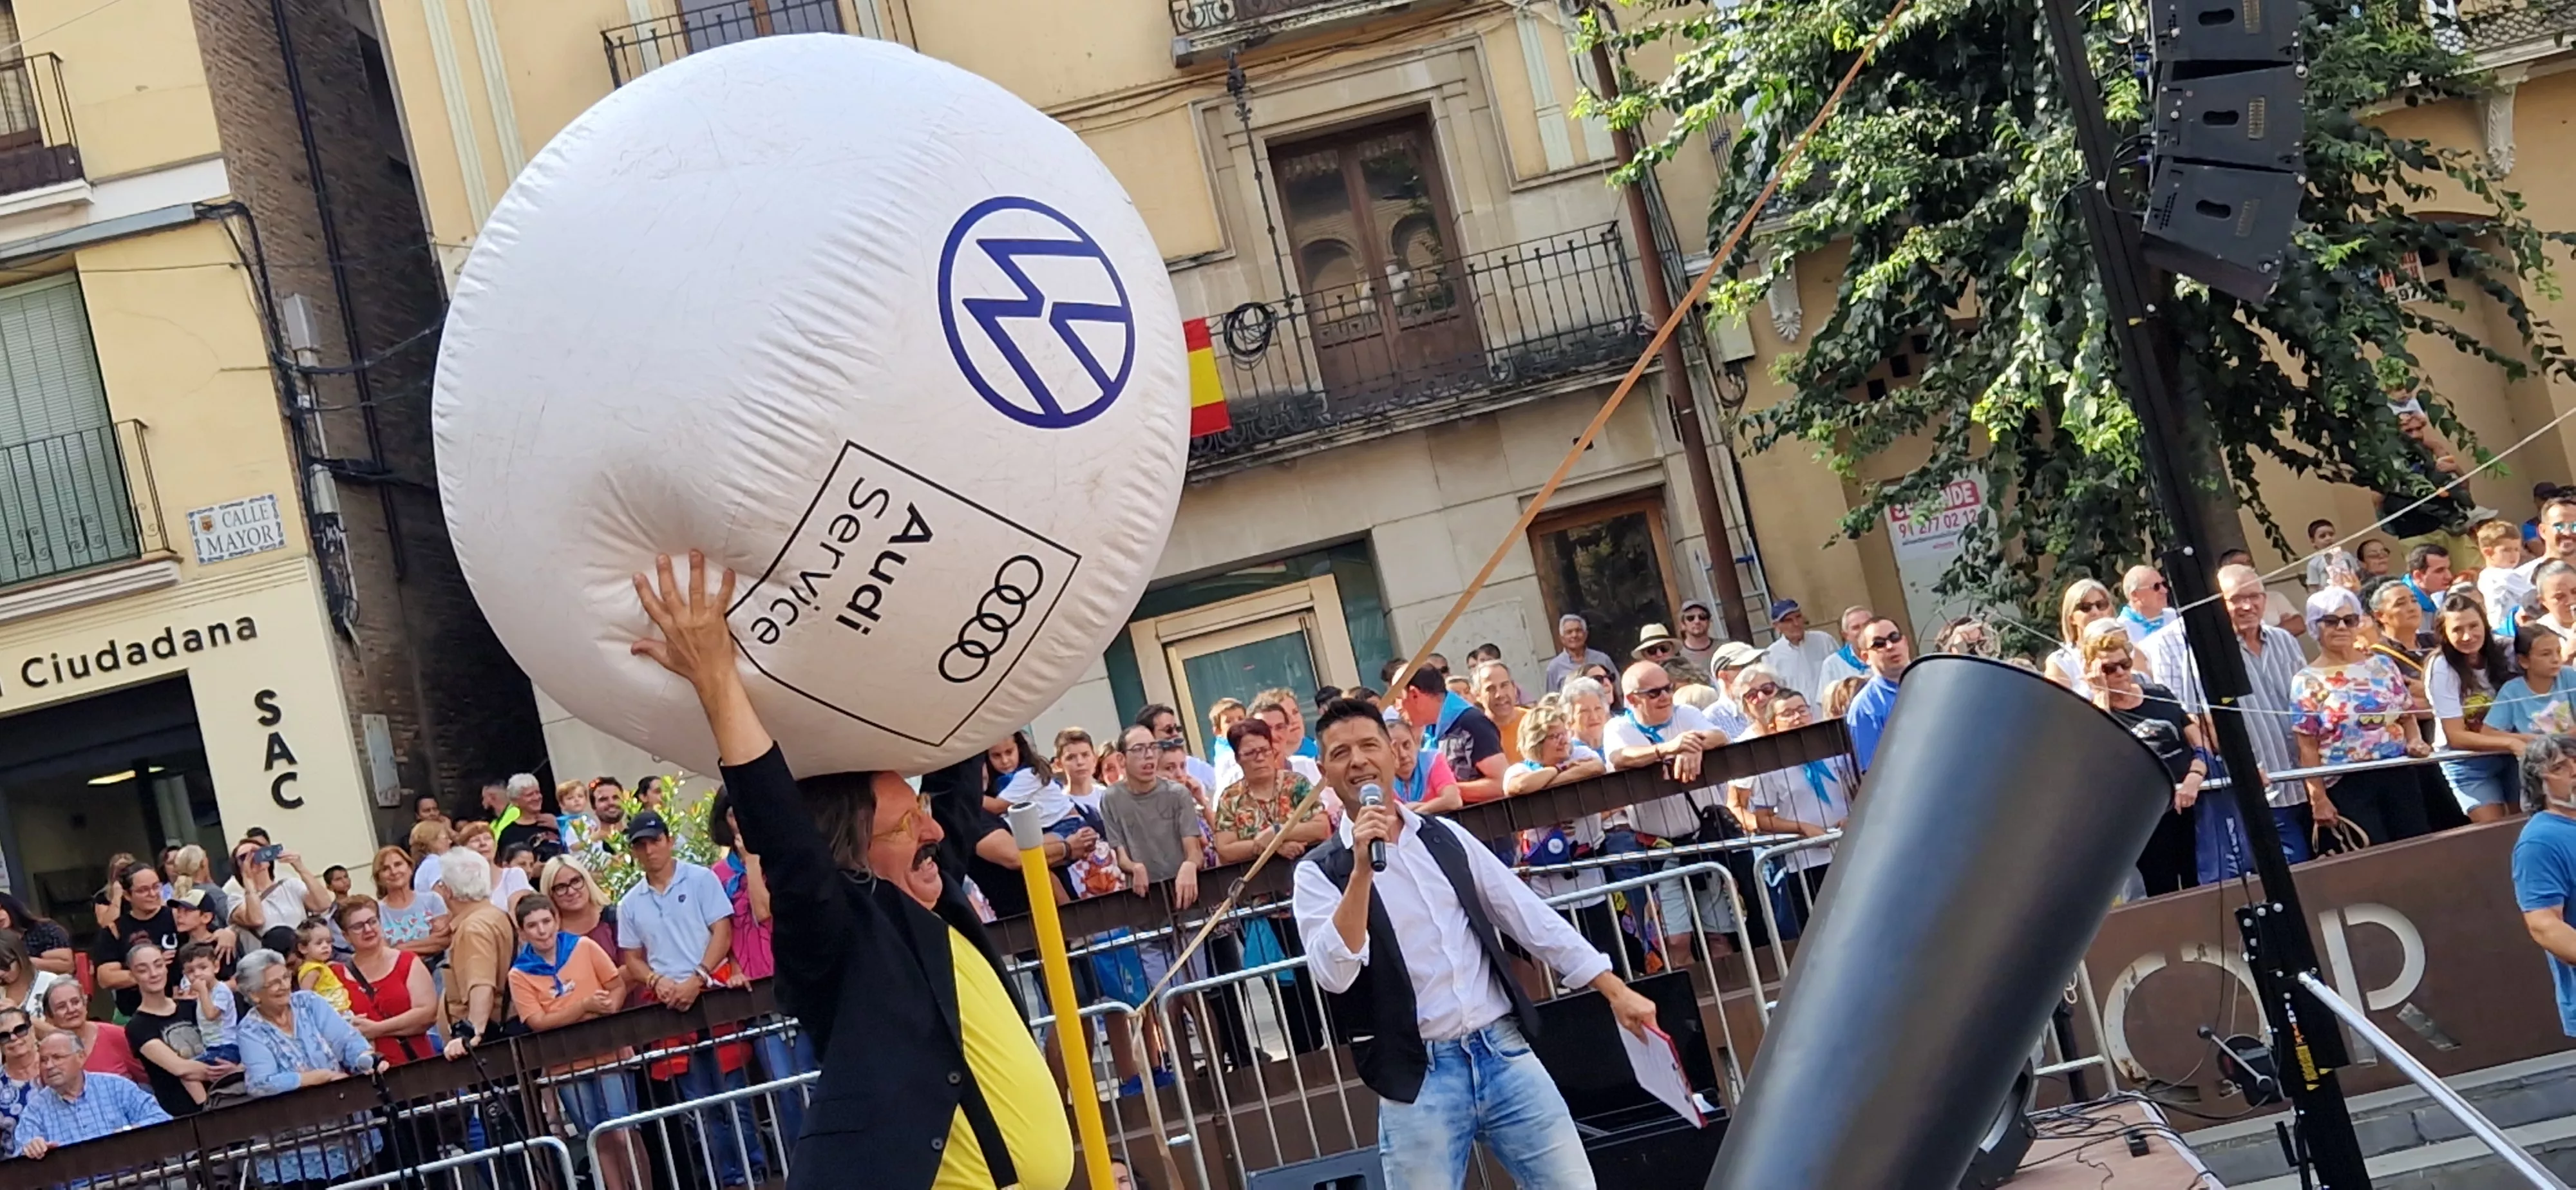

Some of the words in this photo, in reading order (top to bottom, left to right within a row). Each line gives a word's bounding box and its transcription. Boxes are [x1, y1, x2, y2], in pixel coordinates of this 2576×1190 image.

[205, 524, 276, 556] MAYOR
[222, 503, 270, 528] CALLE
[1944, 513, 1960, 529] 02
[1962, 508, 1978, 524] 12
[750, 477, 891, 646] Service
[836, 502, 933, 636] Audi
[21, 616, 258, 688] Ciudadana
[254, 689, 305, 809] SAC
